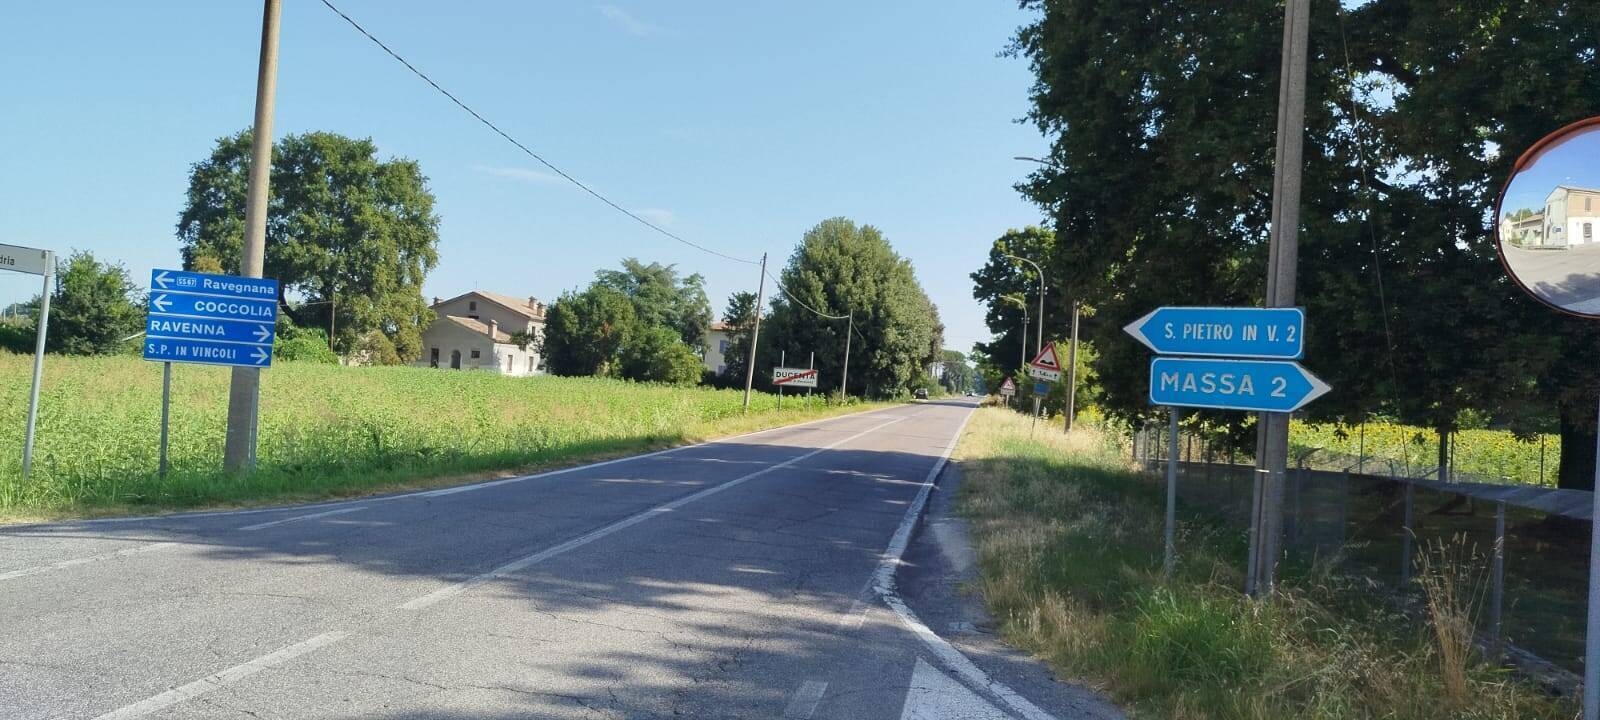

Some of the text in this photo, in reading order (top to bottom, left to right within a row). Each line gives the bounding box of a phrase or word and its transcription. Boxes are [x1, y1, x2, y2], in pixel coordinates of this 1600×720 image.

[203, 278, 275, 295] Ravegnana
[194, 301, 273, 317] COCCOLIA
[151, 320, 226, 336] RAVENNA
[1164, 322, 1296, 342] S. PIETRO IN V. 2
[148, 343, 236, 359] S.P. IN VINCOLI
[775, 371, 816, 380] DUCENTA
[1160, 371, 1287, 398] MASSA 2
